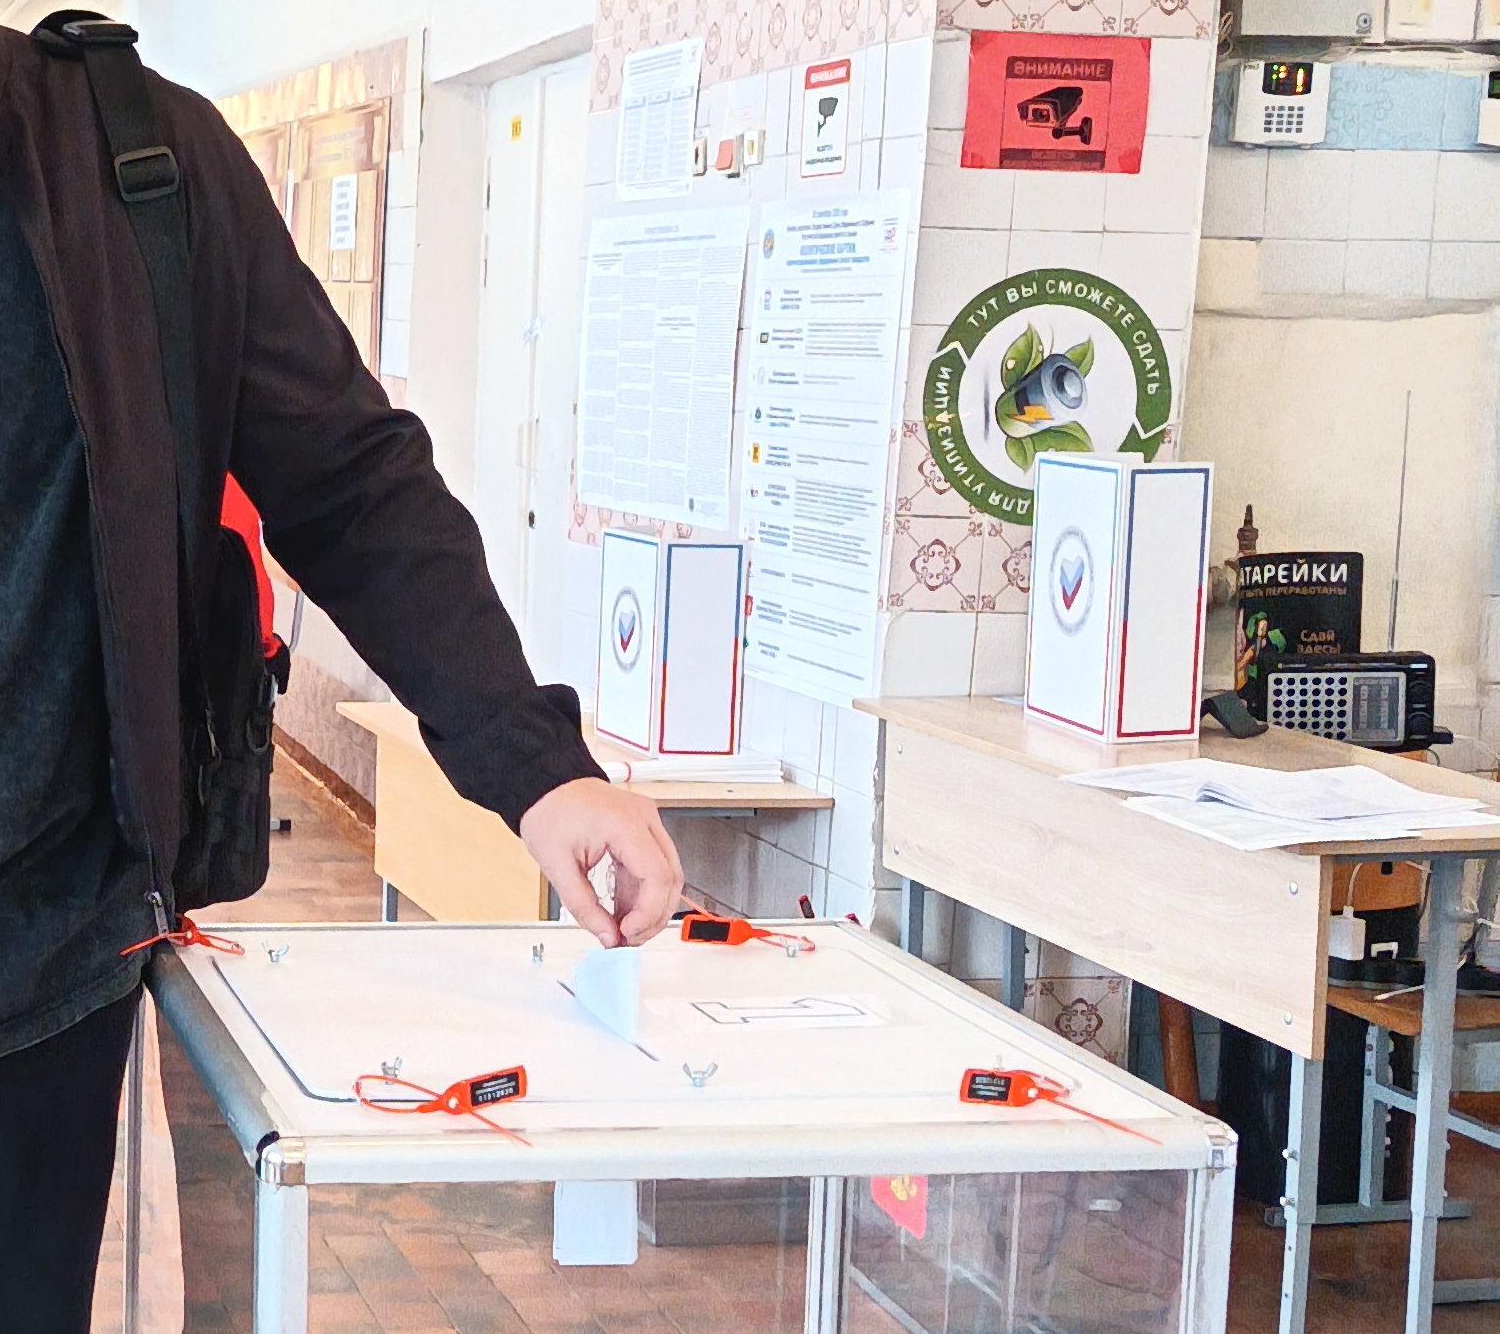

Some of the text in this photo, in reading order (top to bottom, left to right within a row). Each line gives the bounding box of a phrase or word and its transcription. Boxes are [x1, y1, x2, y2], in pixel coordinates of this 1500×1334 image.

[1013, 60, 1108, 78] ВНИМАНИЕ
[965, 278, 1163, 396] ТУТ ВЫ СМОЖЕТЕ СДАТЬ
[933, 366, 1031, 515] ДЛЯ УТИЛИЗАЦИИ
